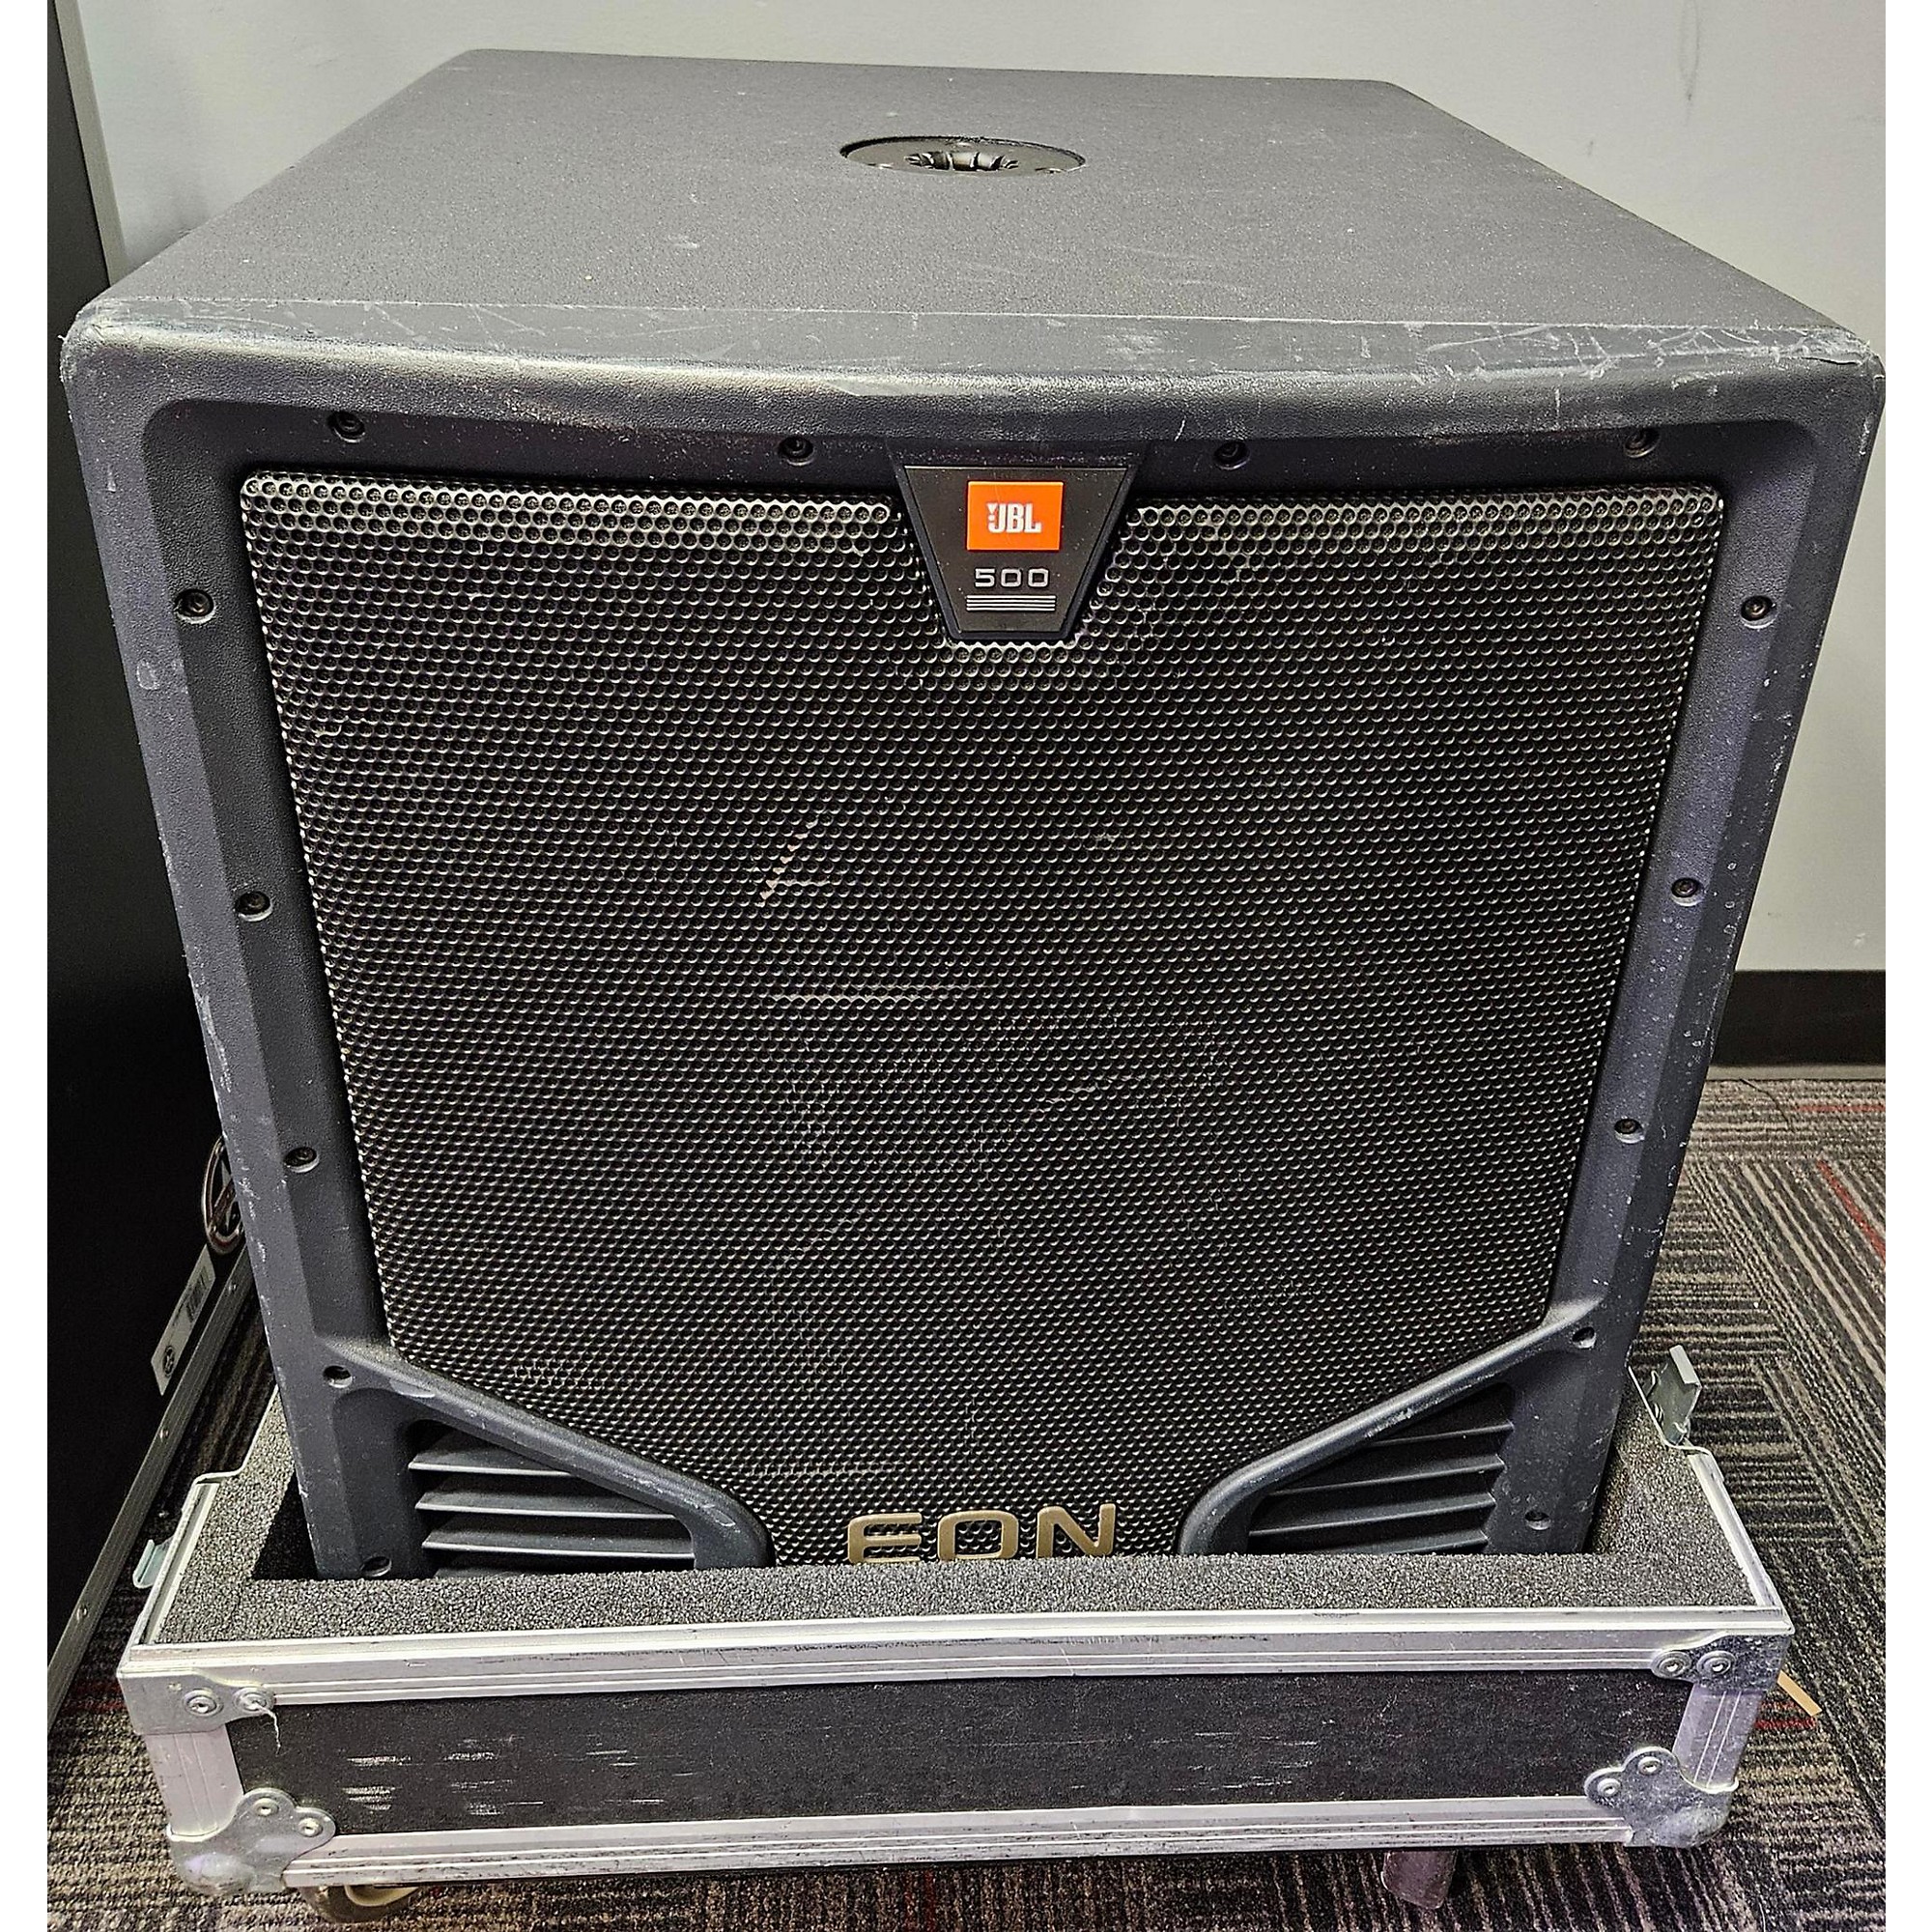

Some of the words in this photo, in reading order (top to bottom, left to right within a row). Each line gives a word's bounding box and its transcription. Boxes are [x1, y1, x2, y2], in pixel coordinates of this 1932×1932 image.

[986, 502, 1042, 533] JBL
[974, 567, 1050, 588] 500
[847, 1502, 1117, 1564] EON
